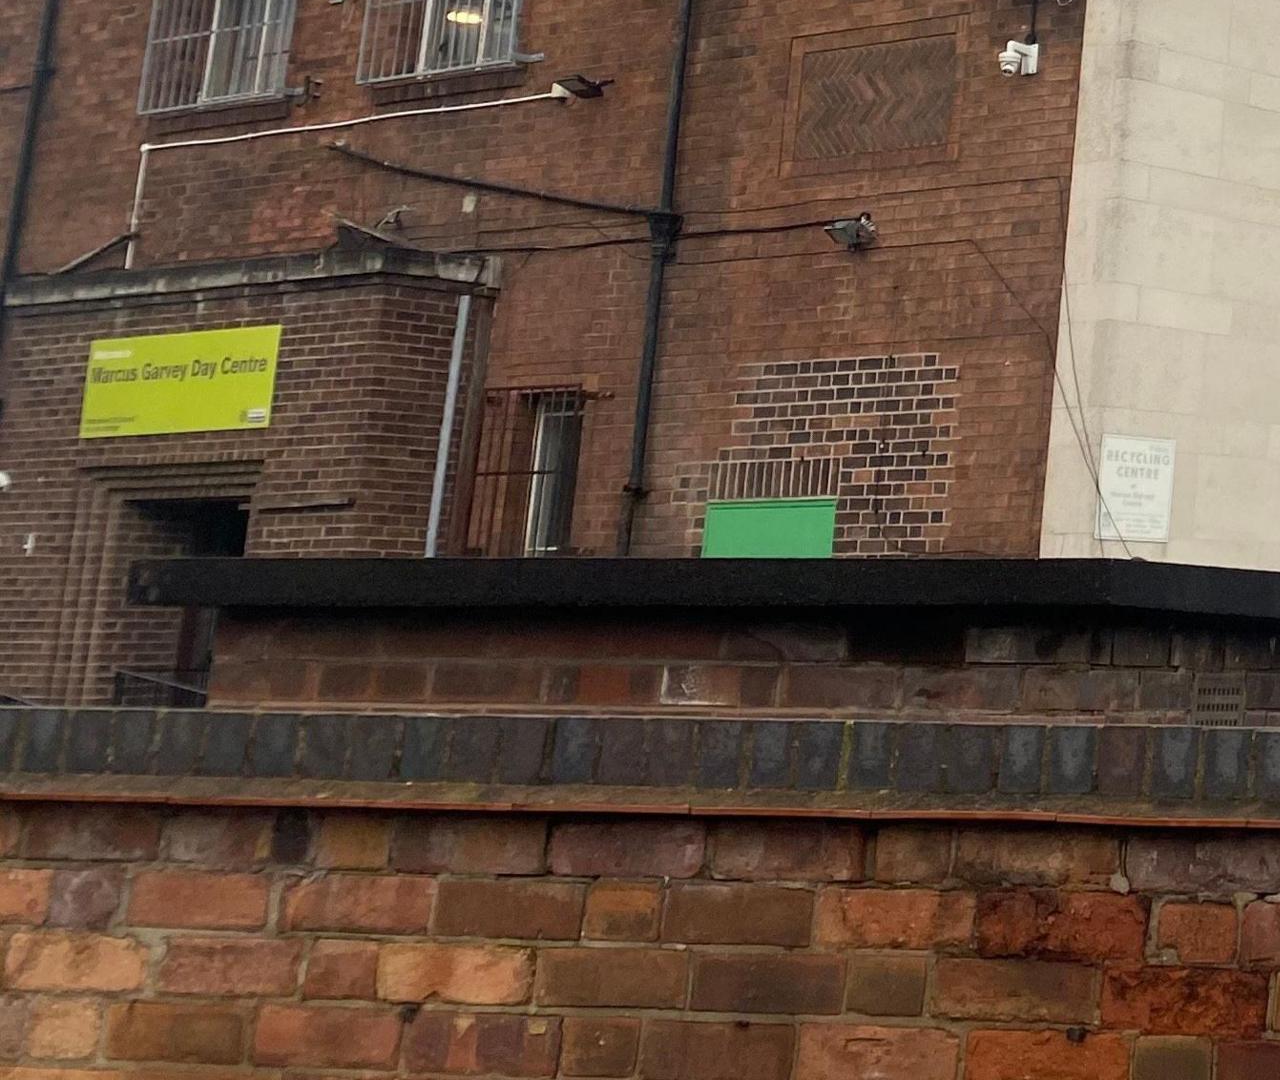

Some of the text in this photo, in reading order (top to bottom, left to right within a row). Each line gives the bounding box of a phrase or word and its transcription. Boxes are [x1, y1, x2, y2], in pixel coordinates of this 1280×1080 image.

[91, 356, 268, 384] Marcus Garvey Day Centre
[1106, 449, 1170, 466] RECYCLING
[1116, 466, 1160, 480] CENTRE
